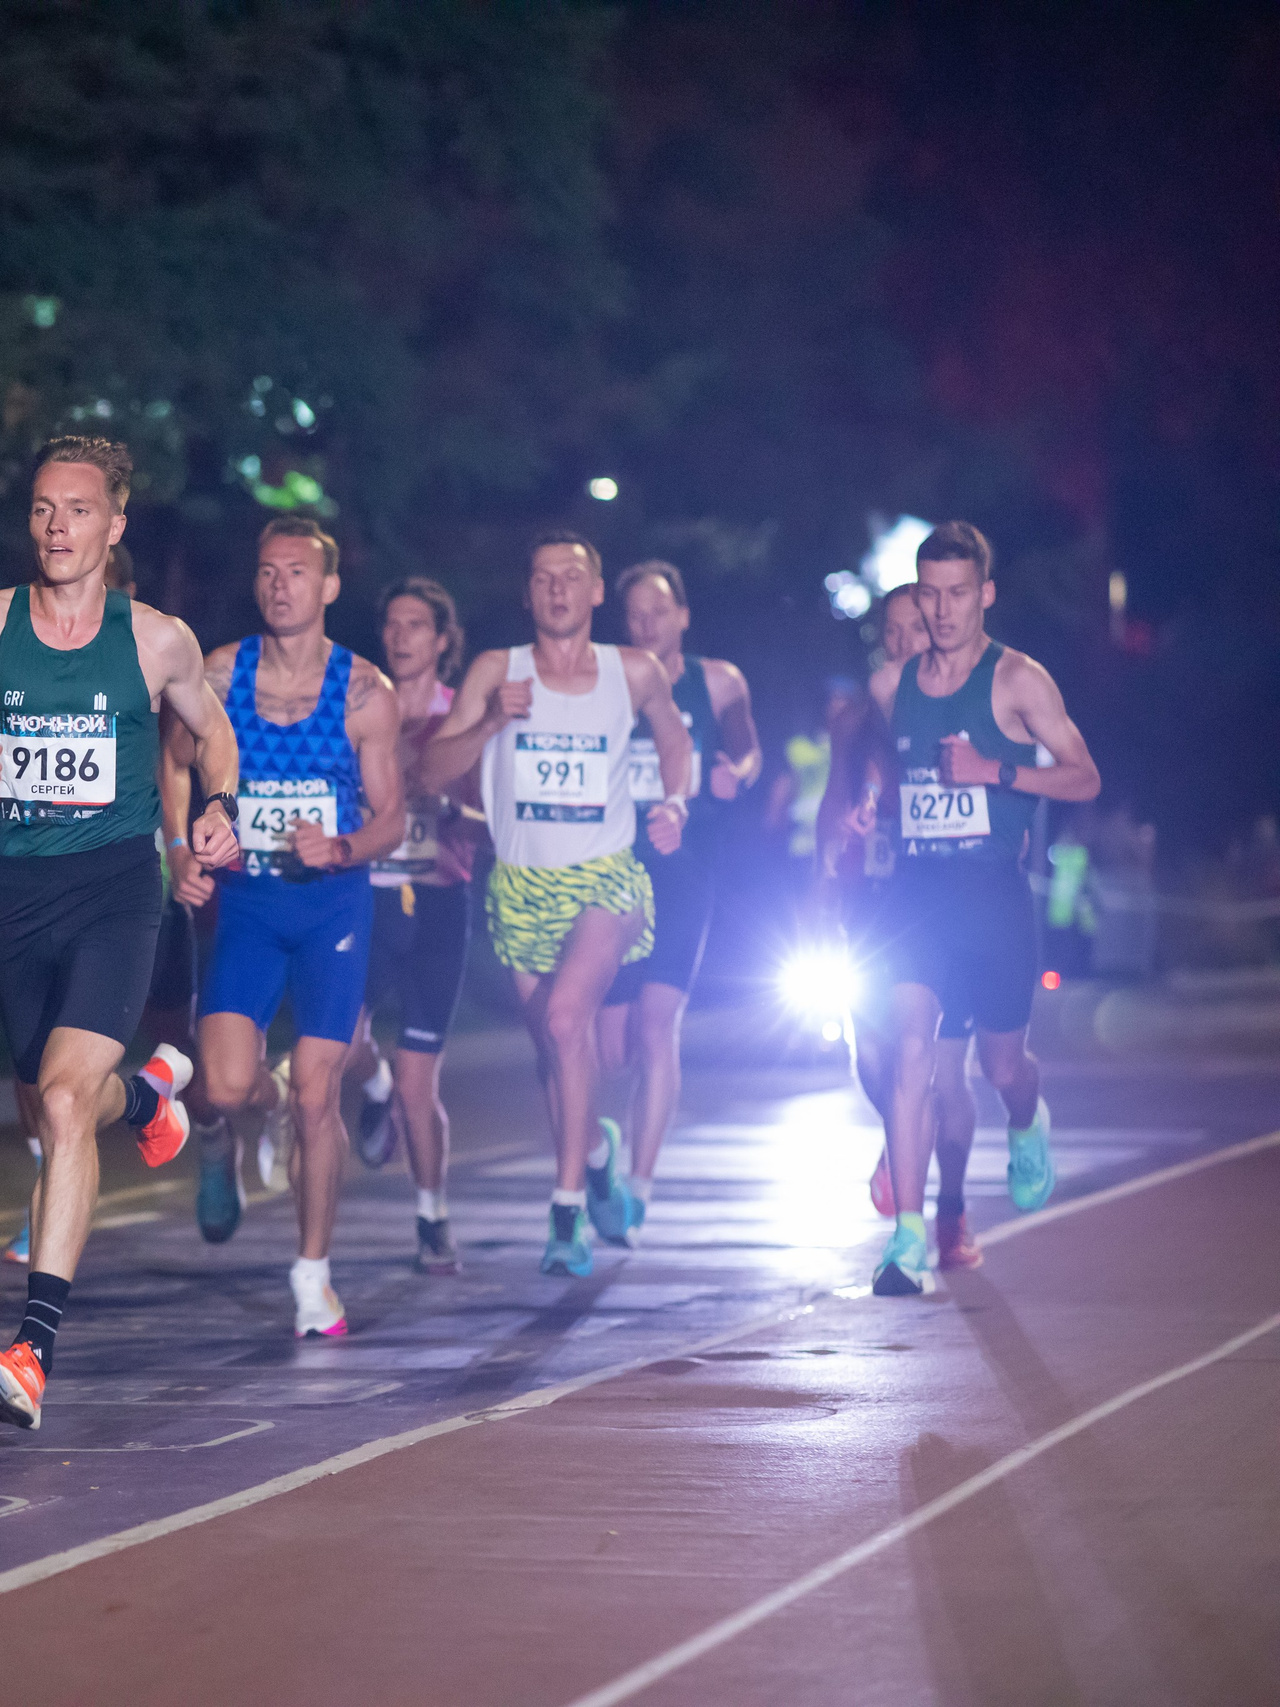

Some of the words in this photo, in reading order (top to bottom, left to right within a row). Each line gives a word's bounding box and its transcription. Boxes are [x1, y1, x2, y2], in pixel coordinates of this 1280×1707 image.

[4, 691, 25, 707] GRi
[8, 713, 107, 733] НОЧНОЙ
[13, 747, 100, 782] 9186
[537, 760, 585, 787] 991
[31, 783, 75, 795] СЕРГЕЙ
[910, 791, 974, 820] 6270
